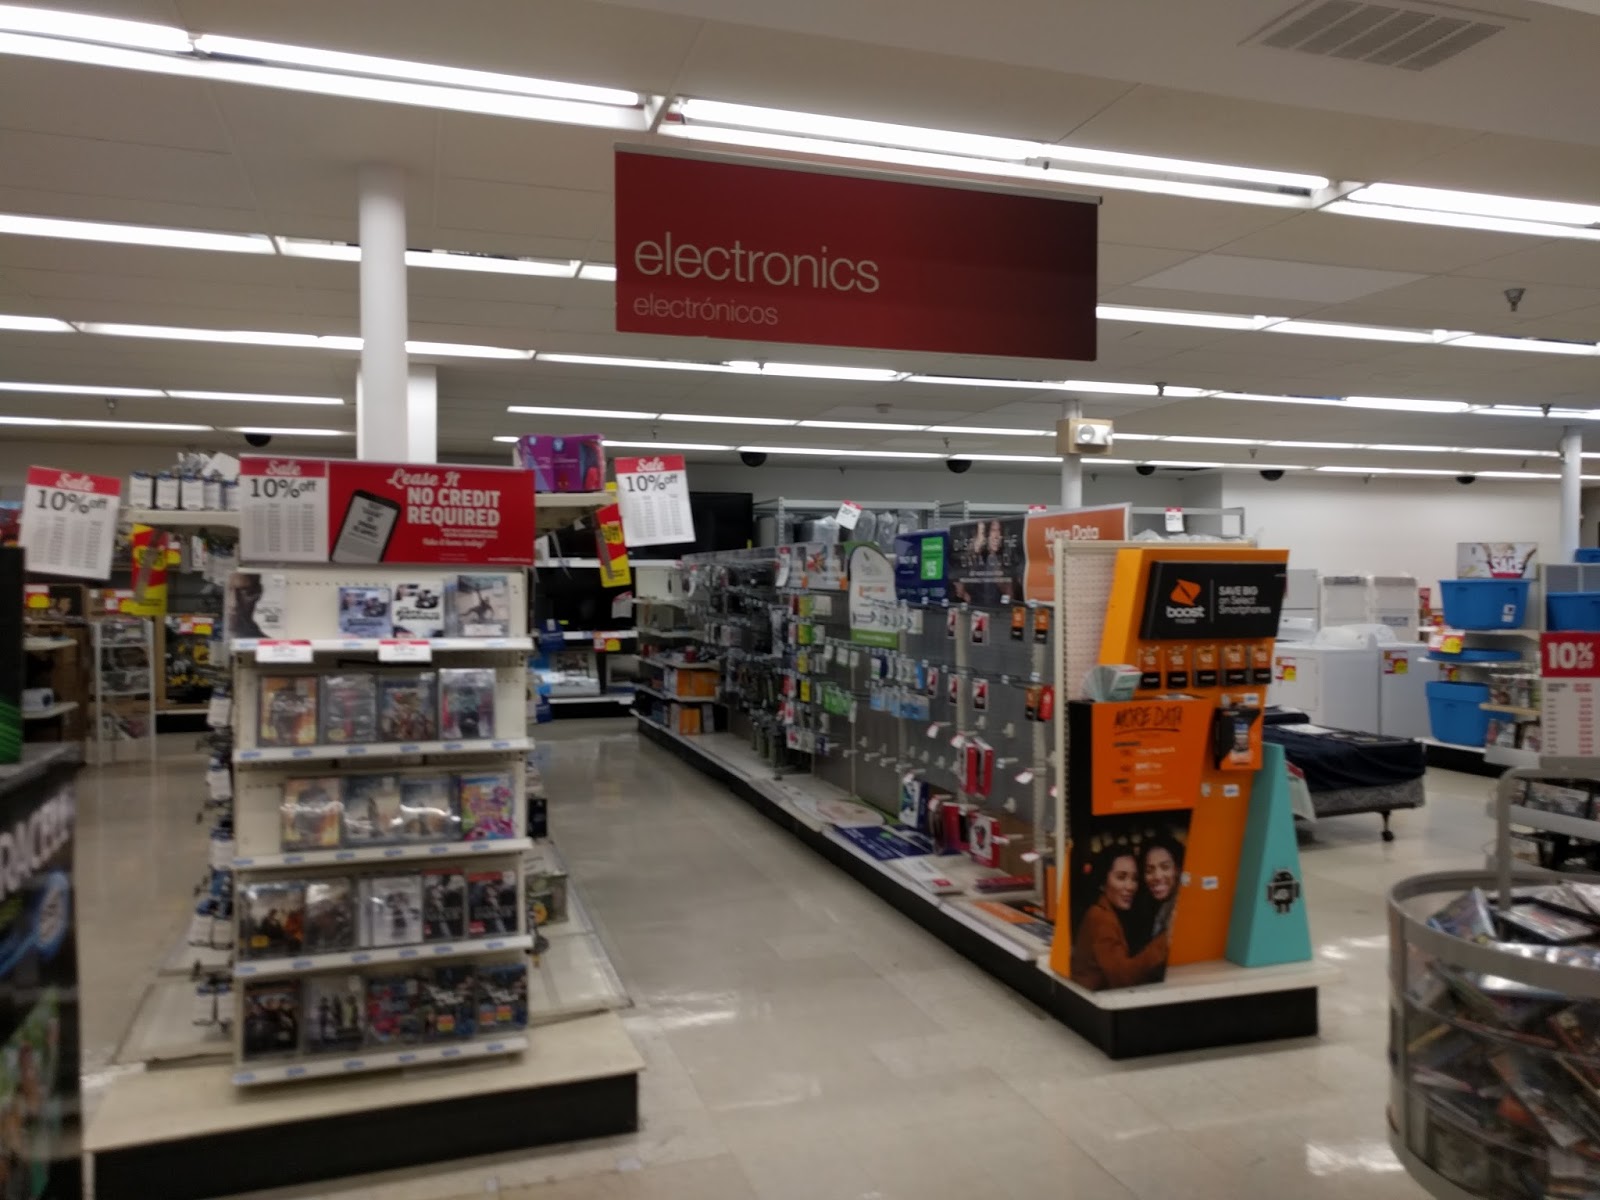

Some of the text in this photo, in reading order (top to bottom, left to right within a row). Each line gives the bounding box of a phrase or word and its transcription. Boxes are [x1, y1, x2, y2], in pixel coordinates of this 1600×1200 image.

[635, 231, 879, 293] electronics
[633, 293, 778, 325] electrónicos
[265, 460, 301, 475] Sale
[636, 456, 665, 472] Sale
[56, 473, 95, 491] Sale
[250, 478, 300, 498] 10%
[386, 468, 439, 489] Lease
[626, 475, 666, 492] 10%
[36, 490, 90, 514] 10%
[407, 488, 501, 508] NO CREDIT
[407, 506, 501, 527] REQUIRED
[1072, 524, 1099, 540] Data
[1165, 605, 1205, 618] boost
